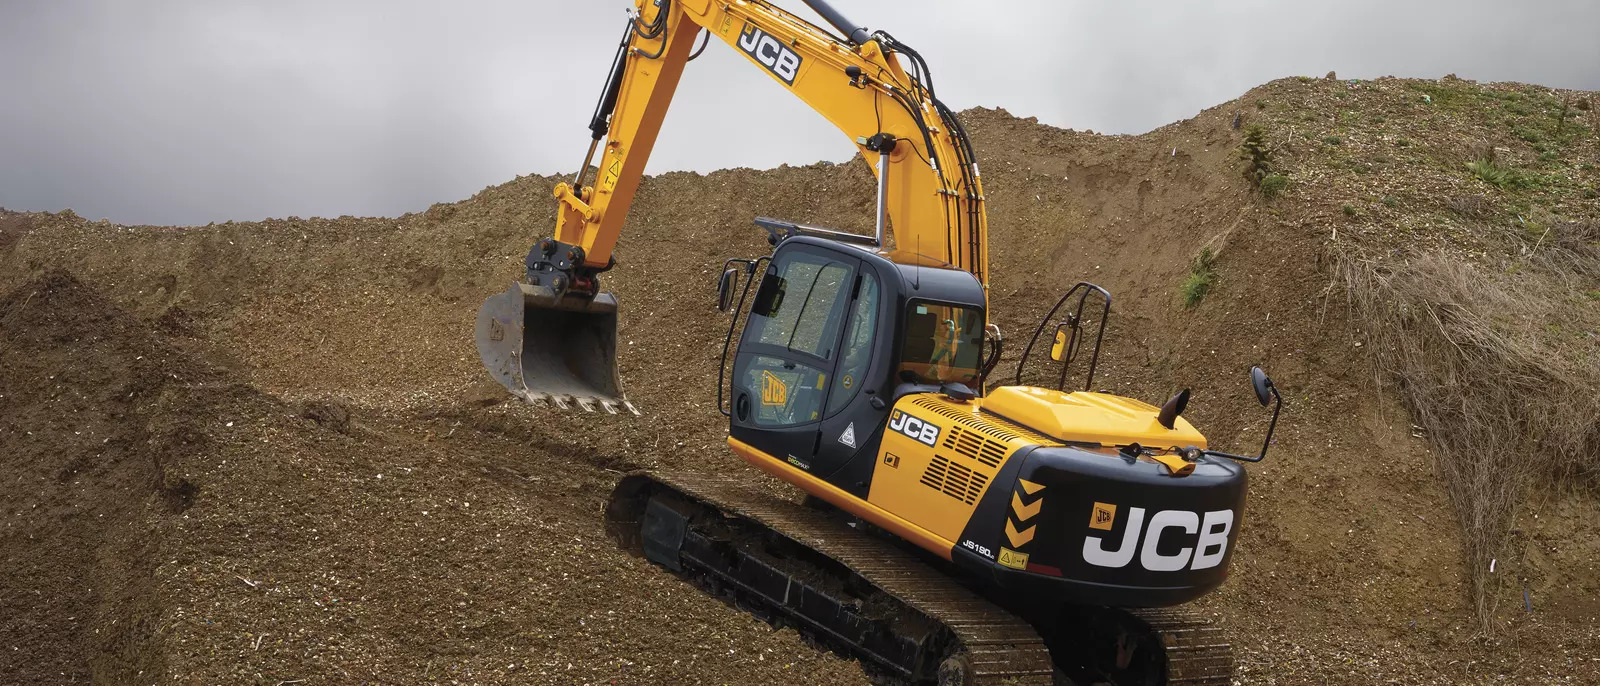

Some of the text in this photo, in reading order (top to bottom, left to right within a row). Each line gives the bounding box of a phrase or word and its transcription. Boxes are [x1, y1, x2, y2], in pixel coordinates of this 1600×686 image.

[740, 28, 799, 81] JCB
[764, 375, 785, 402] JCB
[890, 413, 938, 445] JCB
[1097, 509, 1111, 522] JCB
[1082, 506, 1234, 572] JCB
